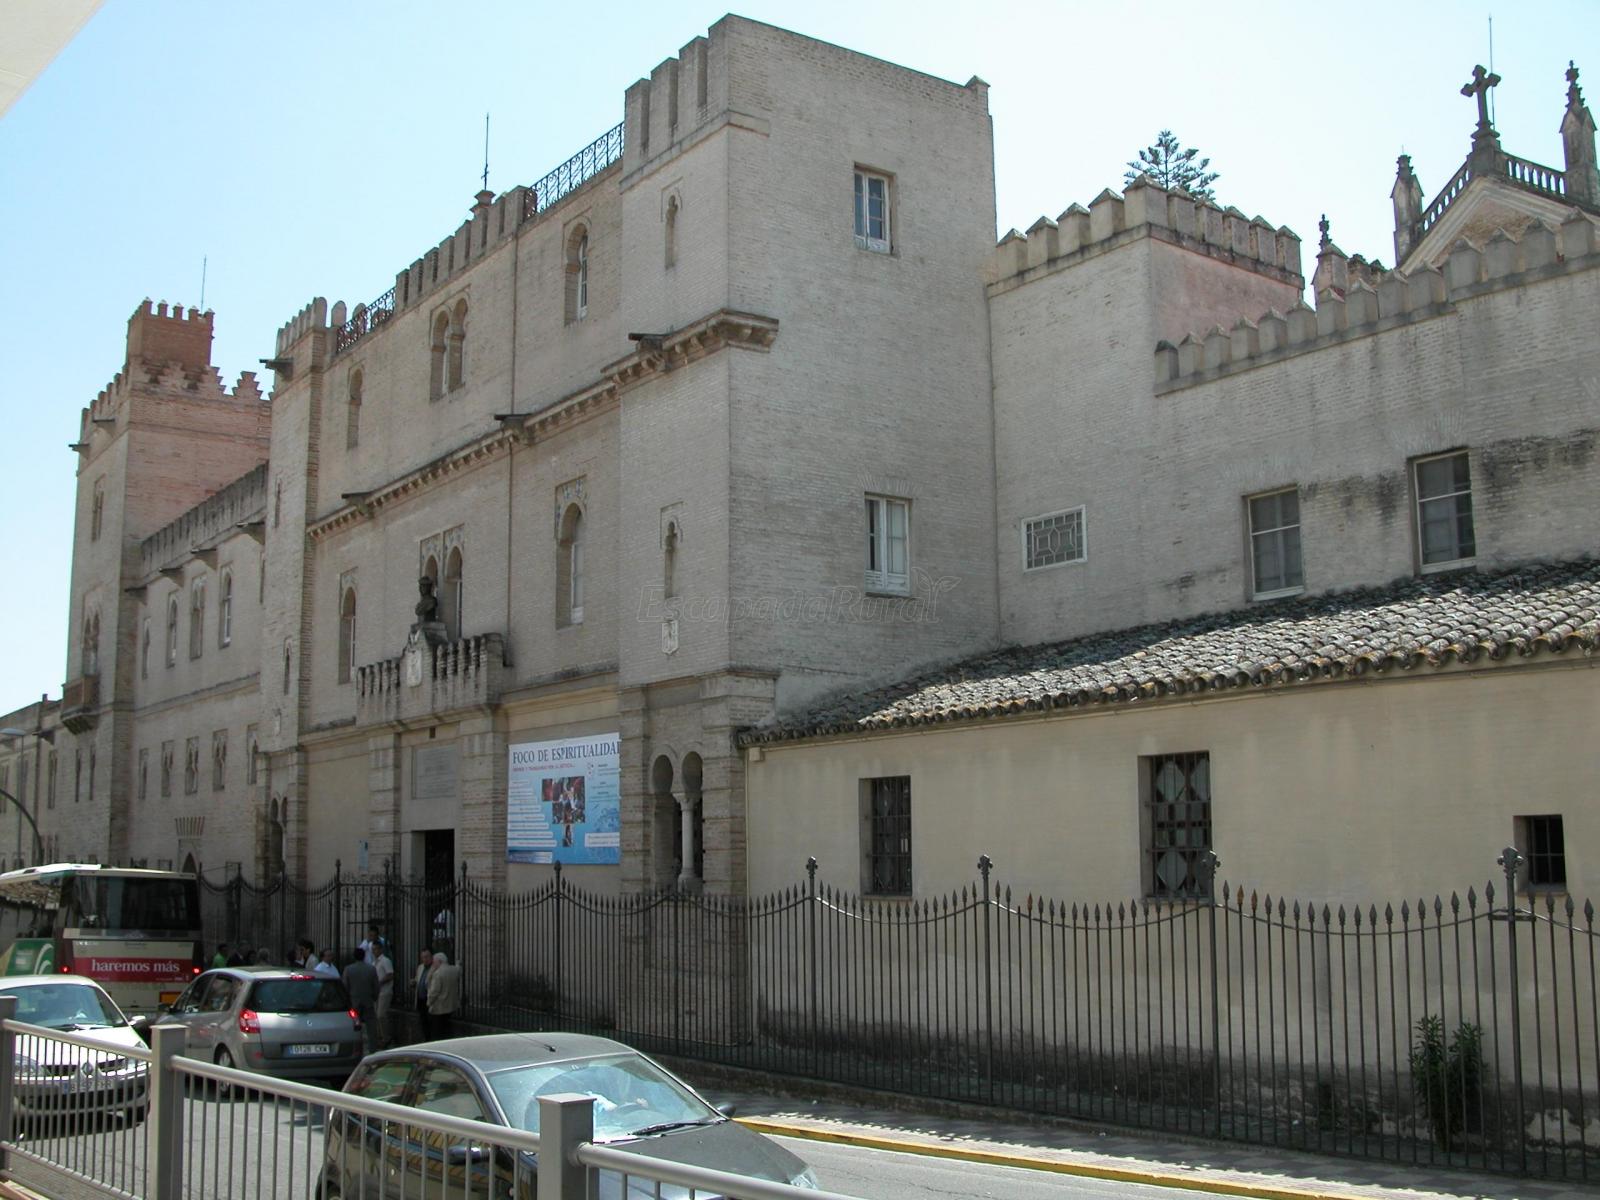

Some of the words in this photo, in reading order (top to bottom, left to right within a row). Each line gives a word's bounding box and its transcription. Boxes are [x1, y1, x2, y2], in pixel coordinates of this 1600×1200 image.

[513, 750, 535, 764] FOCO
[538, 749, 549, 762] DE
[91, 959, 150, 972] haremos
[153, 960, 180, 973] más
